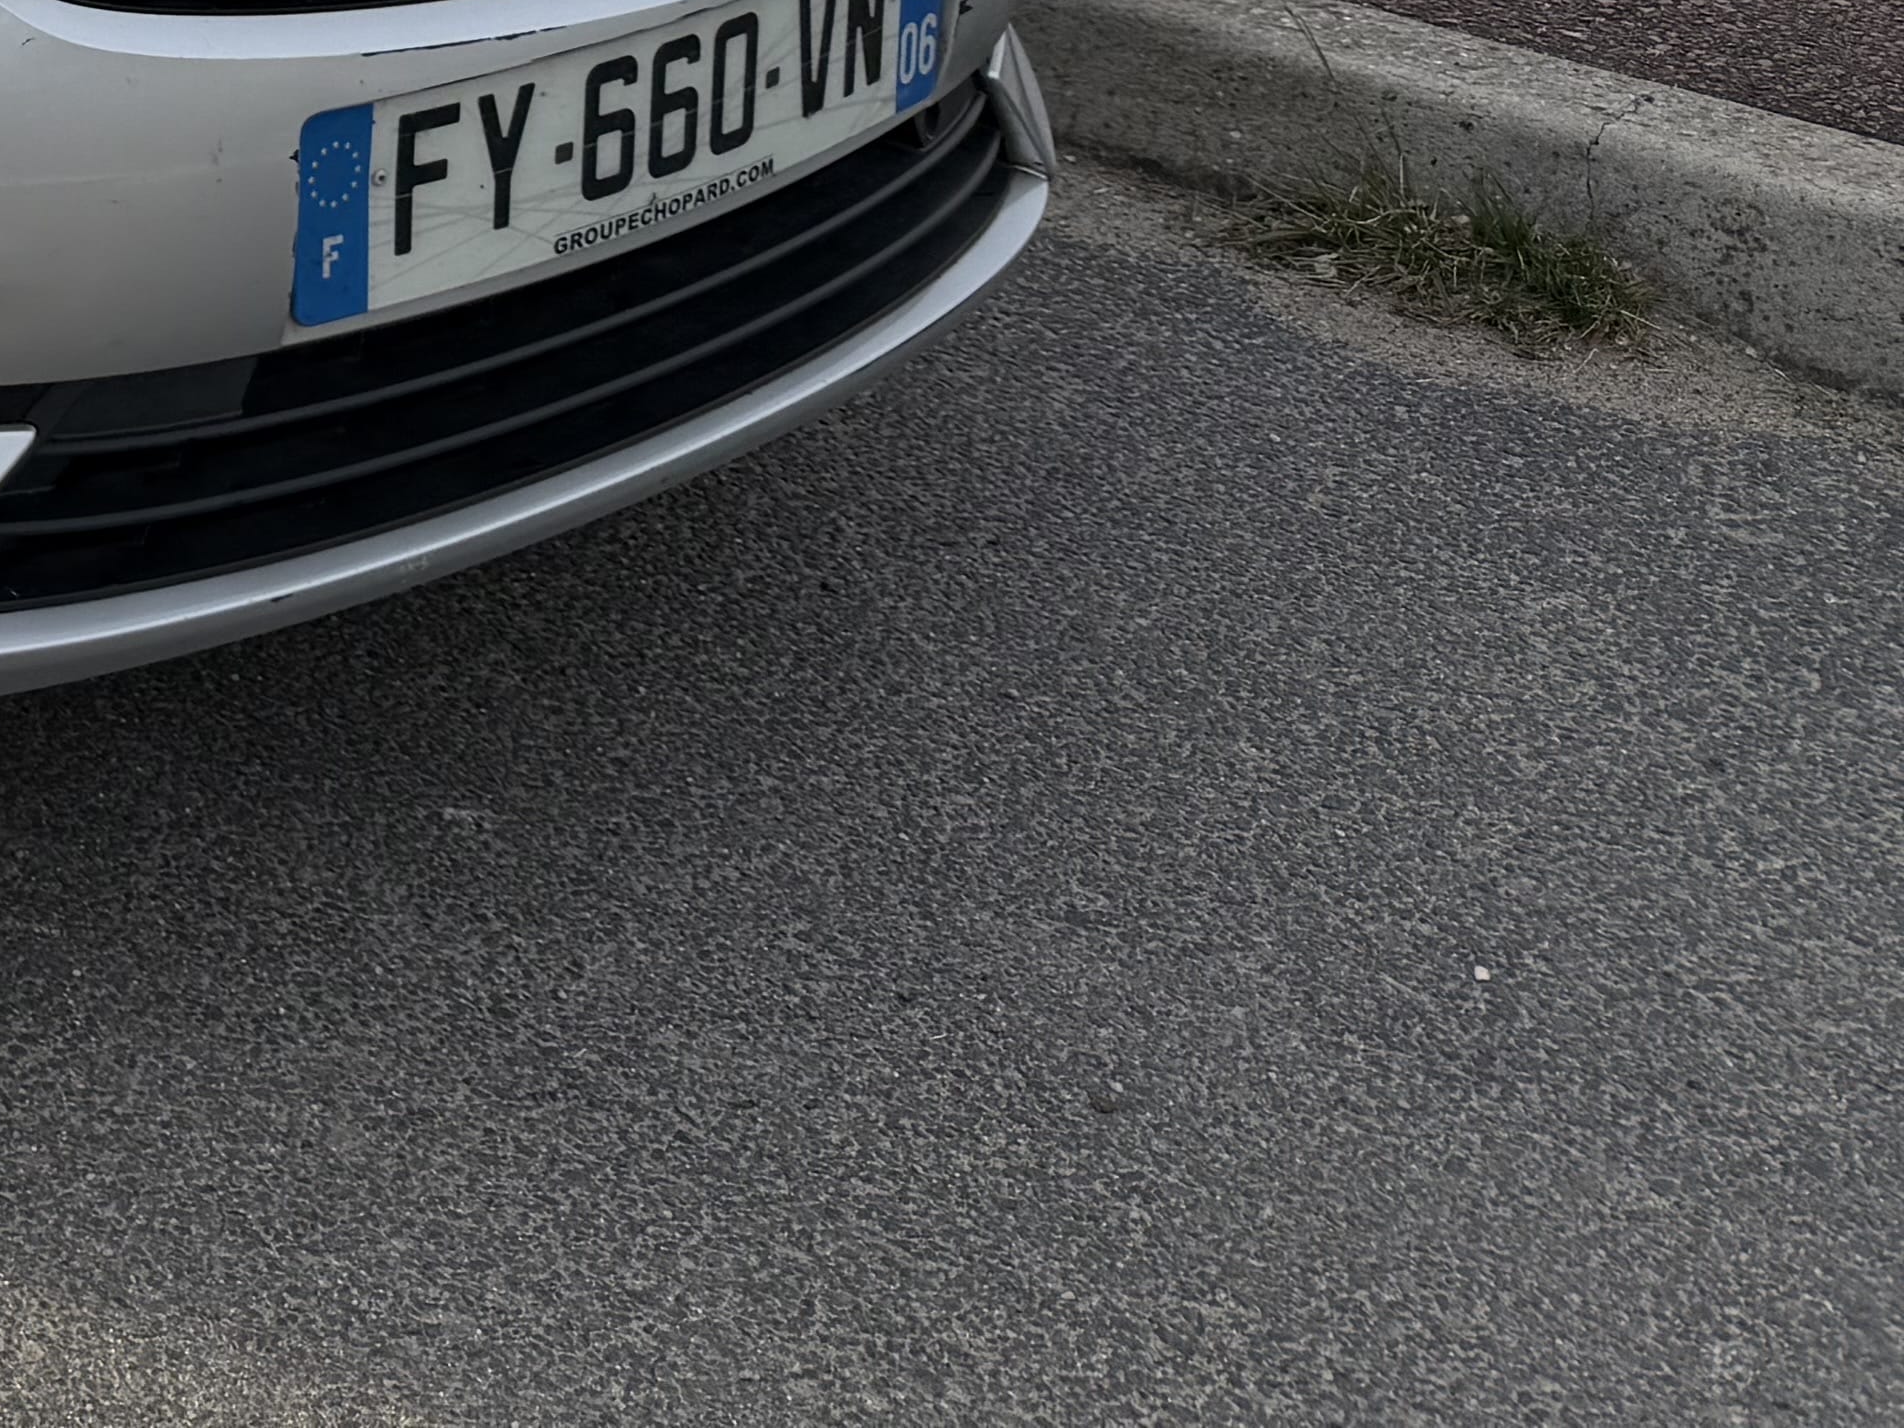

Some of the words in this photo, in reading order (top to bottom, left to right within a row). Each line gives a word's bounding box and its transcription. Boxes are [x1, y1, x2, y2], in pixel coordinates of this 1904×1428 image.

[900, 13, 938, 84] 06
[553, 159, 775, 254] GROUPECHOPARD.COM
[322, 235, 344, 278] F
